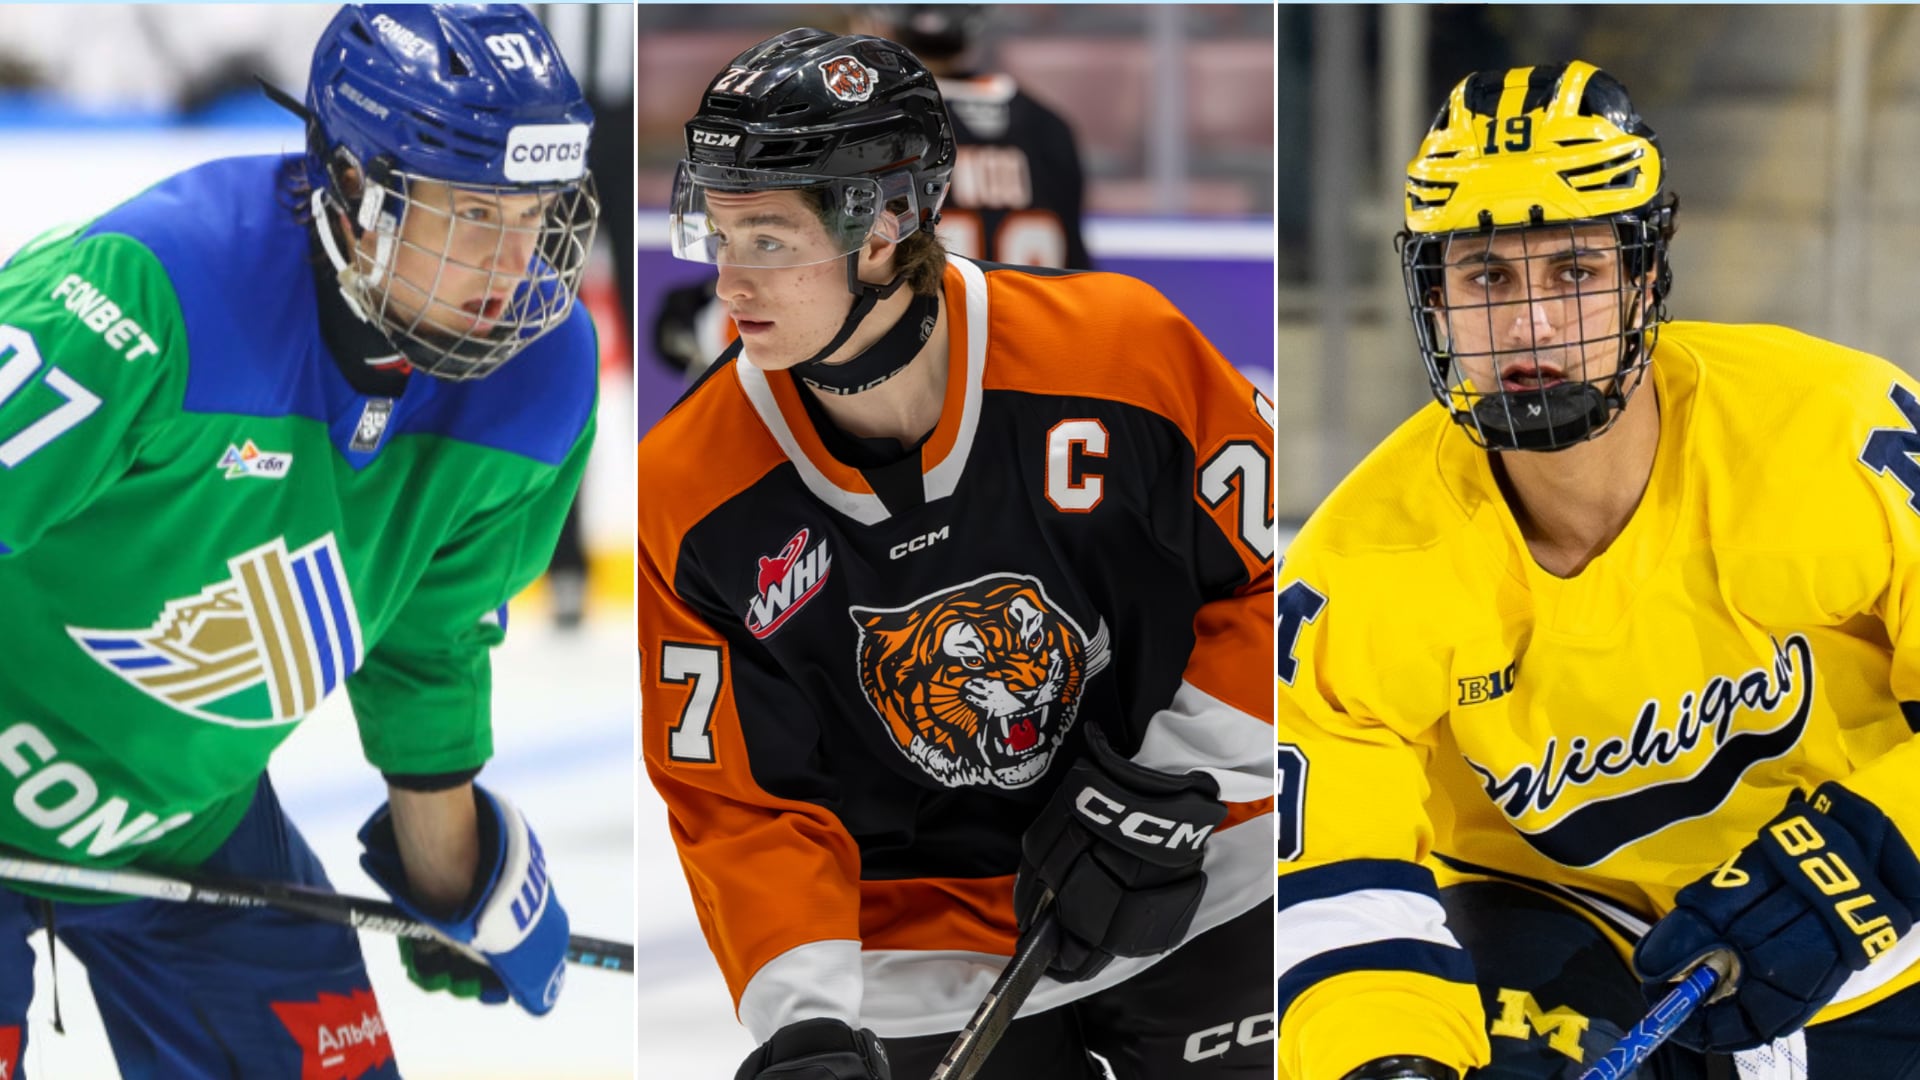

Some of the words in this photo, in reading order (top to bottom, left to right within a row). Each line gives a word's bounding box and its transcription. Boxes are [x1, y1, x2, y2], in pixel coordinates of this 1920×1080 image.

[371, 12, 434, 59] FONBET
[485, 32, 547, 78] 97
[511, 142, 582, 163] согаз
[692, 129, 741, 148] CCM
[1483, 115, 1532, 156] 19
[51, 273, 160, 362] FONBET
[1044, 417, 1110, 514] C
[1196, 386, 1275, 566] 2
[889, 525, 950, 561] CCM
[749, 538, 833, 628] WHL
[638, 639, 724, 764] 7
[1463, 632, 1812, 822] Michigan
[1075, 786, 1215, 850] CCM
[1490, 987, 1590, 1064] M
